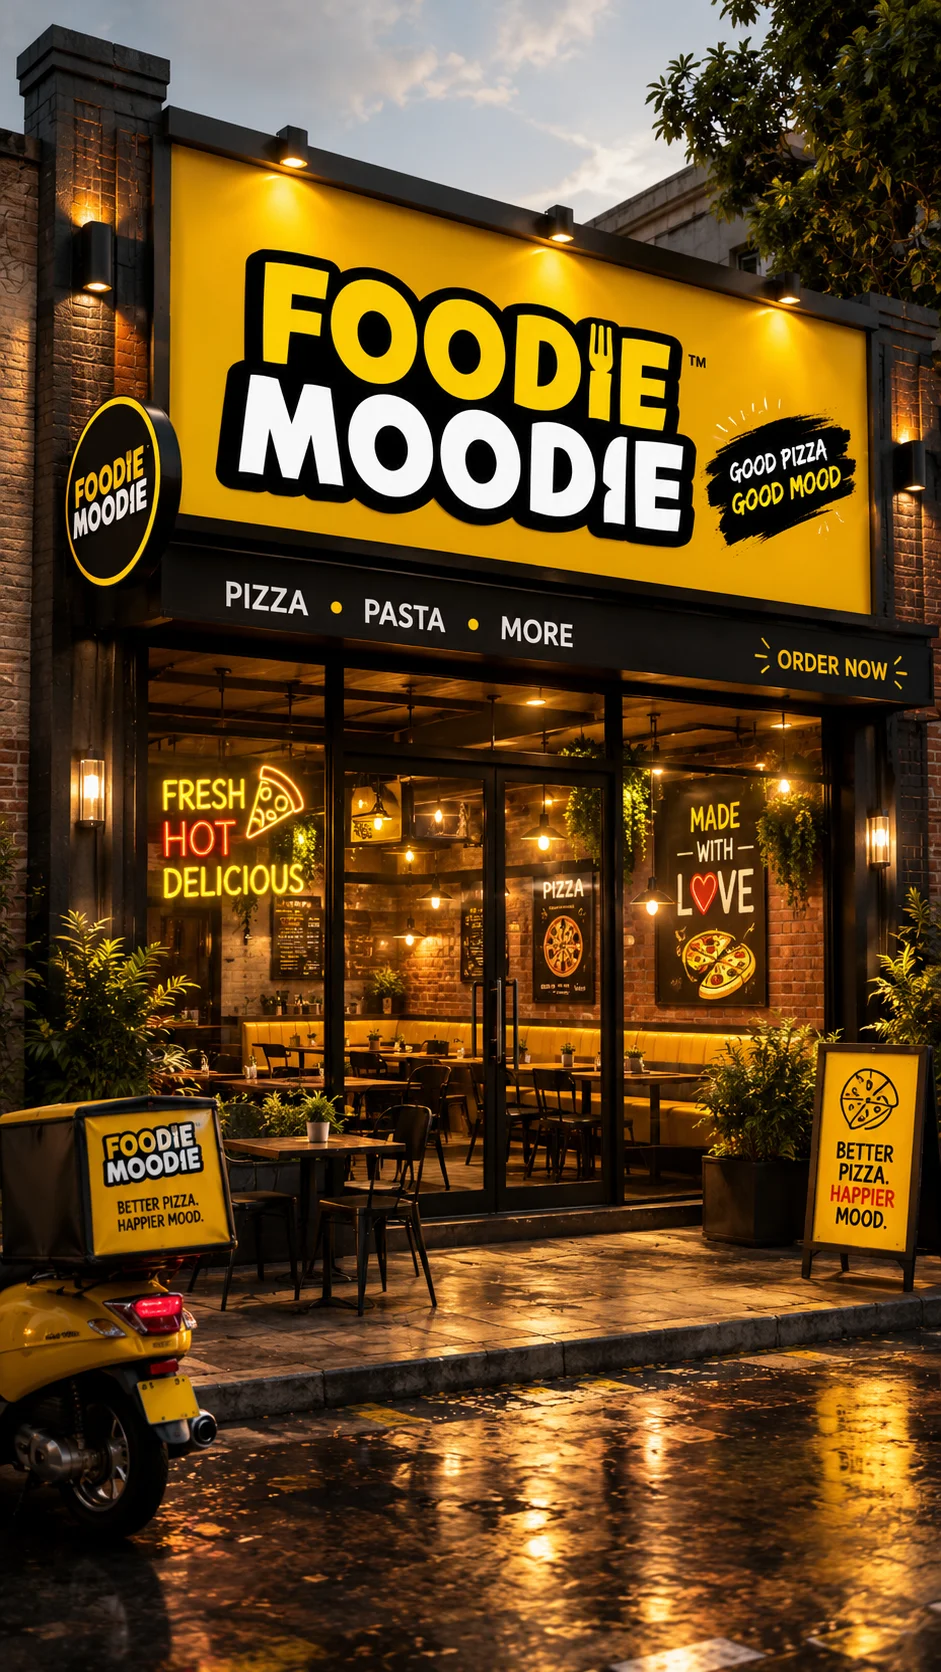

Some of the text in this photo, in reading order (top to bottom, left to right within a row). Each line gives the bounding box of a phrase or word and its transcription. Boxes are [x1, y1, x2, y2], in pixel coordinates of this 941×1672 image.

[263, 261, 671, 431] FOODIE
[688, 354, 707, 369] TM
[238, 374, 684, 532] MOODIE
[729, 438, 828, 484] GOOD PIZZA
[74, 445, 144, 509] FOODIE
[732, 465, 842, 516] GOOD MOOD
[73, 477, 147, 540] MOODIE
[225, 580, 574, 648] PIZZA PASTA MORE
[777, 649, 888, 681] ORDER NOW
[162, 778, 245, 811] FRESH
[690, 801, 741, 833] MADE
[164, 820, 236, 858] HOT
[696, 837, 733, 863] WITH
[163, 863, 304, 899] DELICIOUS
[542, 878, 584, 899] PIZZA
[105, 1123, 194, 1160] FOODIE
[836, 1141, 894, 1163] BETTER
[106, 1146, 201, 1184] MOODIE
[839, 1163, 889, 1185] PIZZA.
[117, 1193, 199, 1215] BETTER PIZZA.
[830, 1184, 895, 1209] HAPPIER
[117, 1210, 204, 1232] HAPPIER MOOD.
[835, 1207, 887, 1230] MOOD.
